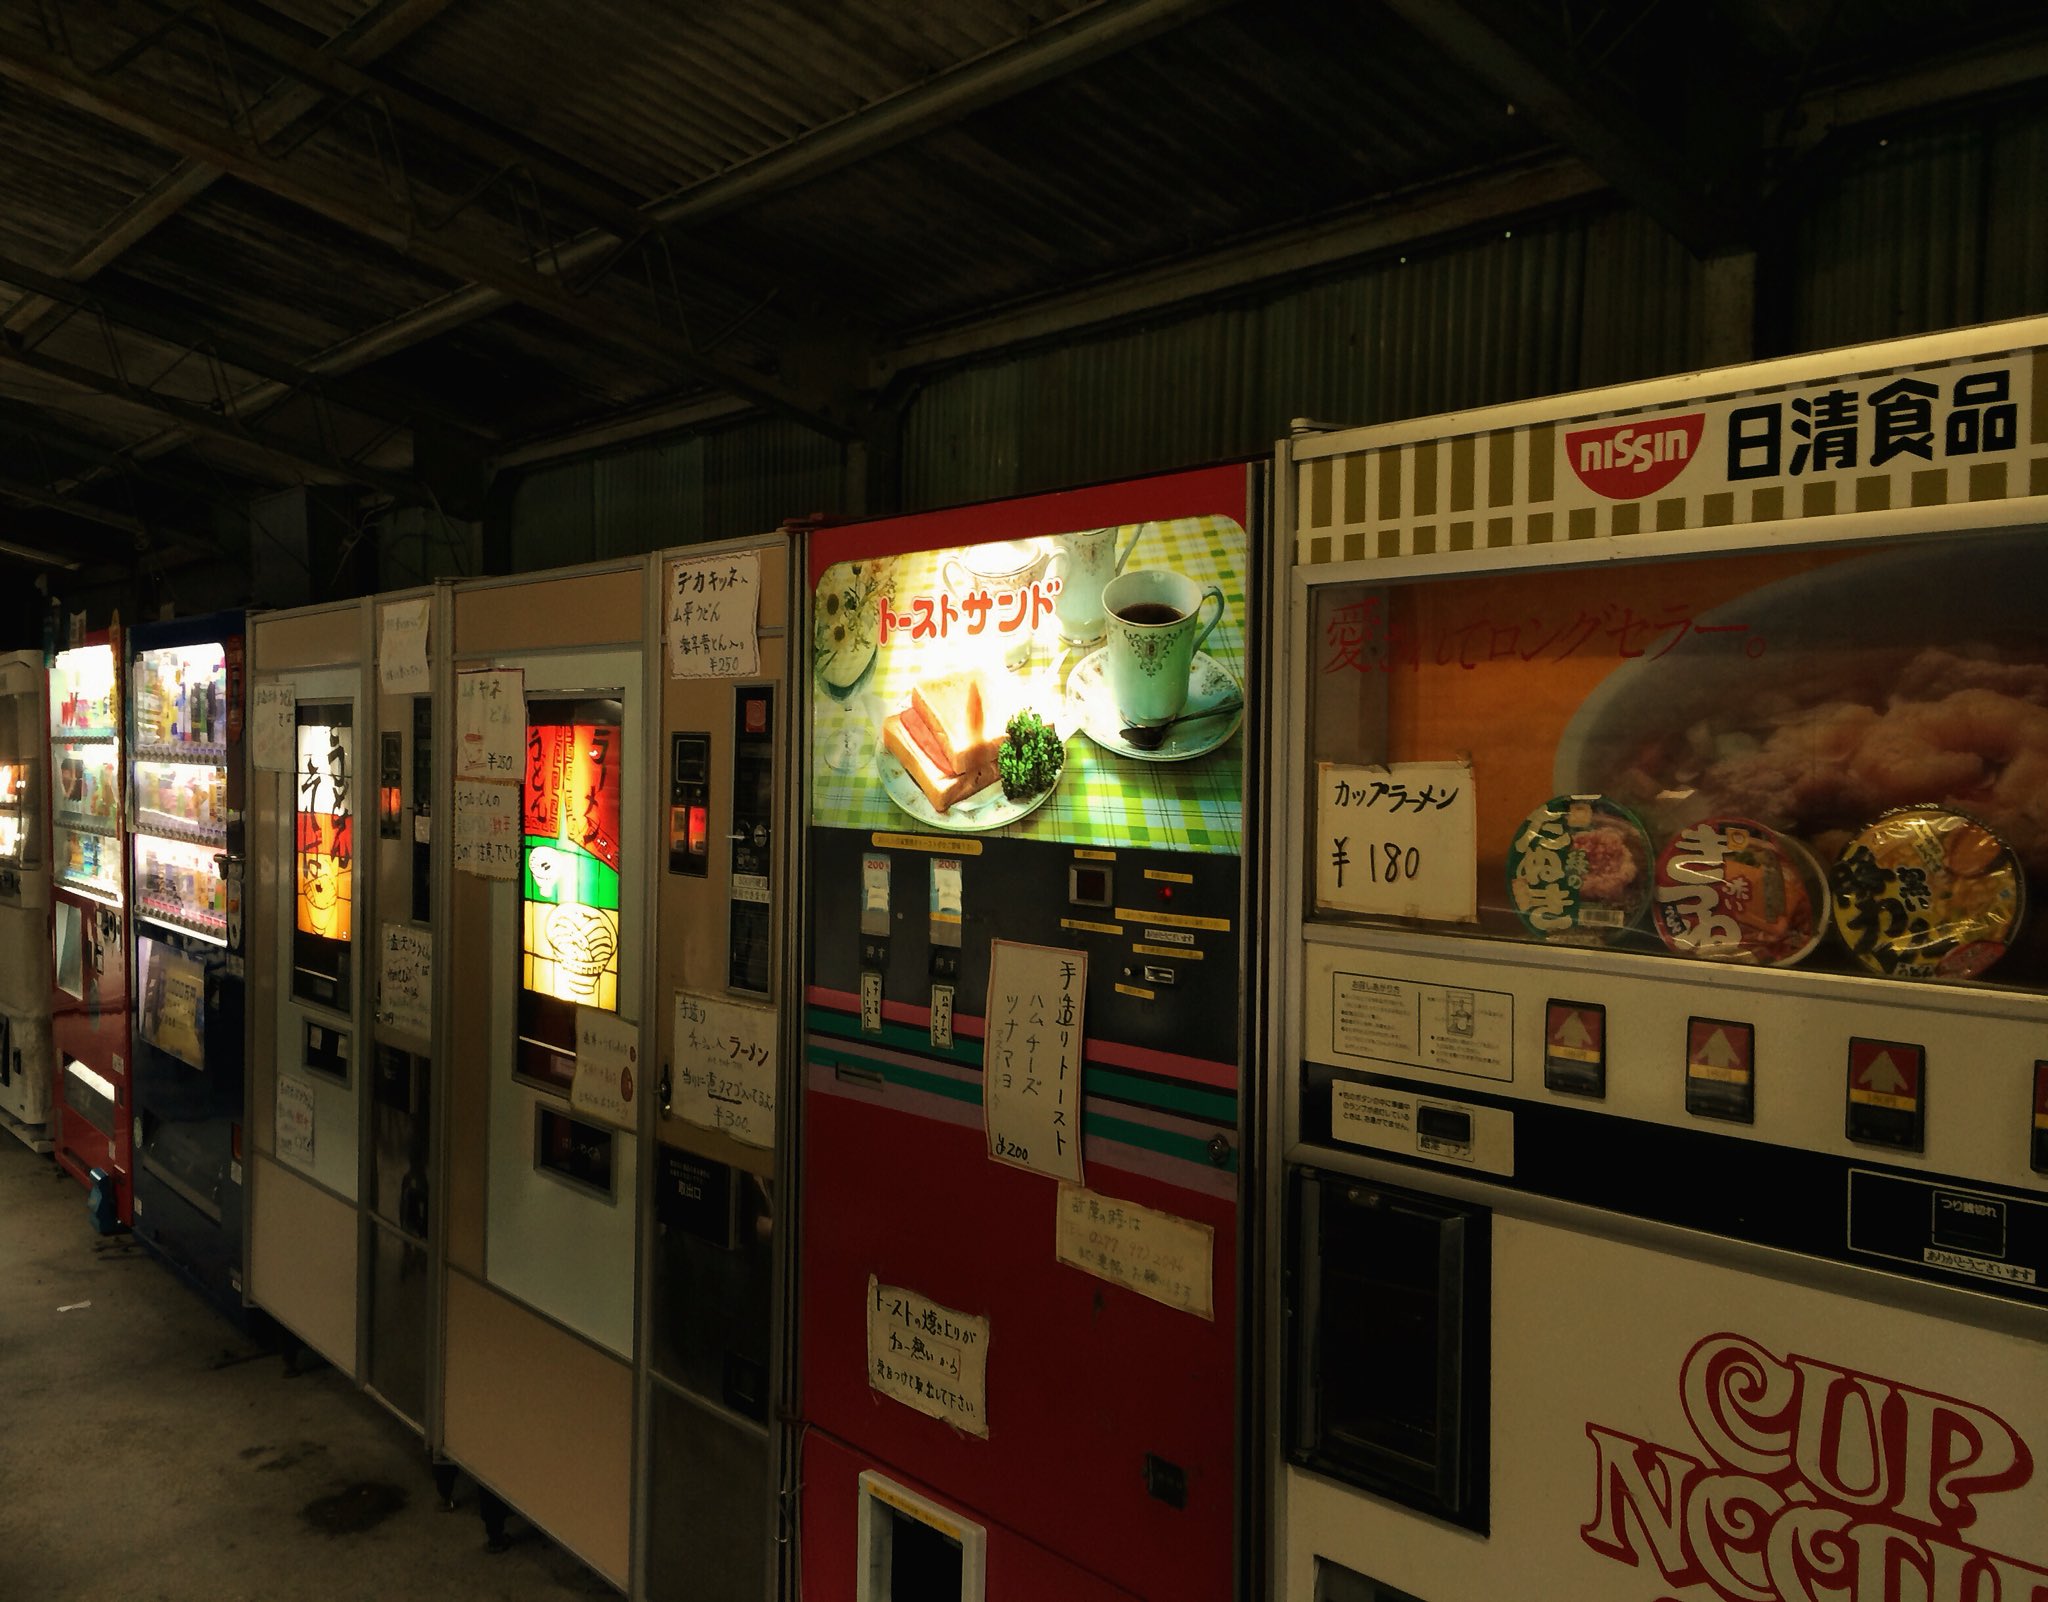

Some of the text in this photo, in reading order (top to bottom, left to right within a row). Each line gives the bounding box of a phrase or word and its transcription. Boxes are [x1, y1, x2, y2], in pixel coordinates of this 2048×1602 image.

[1728, 370, 2018, 482] 日清食品
[880, 579, 1060, 645] トーストサンド
[529, 728, 547, 823] うどん
[584, 729, 611, 848] ラーメン
[1334, 780, 1460, 813] カップラーメン
[867, 861, 884, 870] 200
[938, 860, 957, 870] 200
[1511, 804, 1575, 931] たぬき
[1656, 823, 1742, 952] きつね
[729, 1035, 769, 1068] ラーメン
[865, 986, 876, 1027] トースト
[1001, 994, 1019, 1089] ツナマヨ
[1023, 993, 1045, 1096] ハムチーズ
[1054, 960, 1076, 1156] 手造りトースト
[1679, 1331, 2034, 1530] CUP
[1580, 1421, 2048, 1602] NOOD
